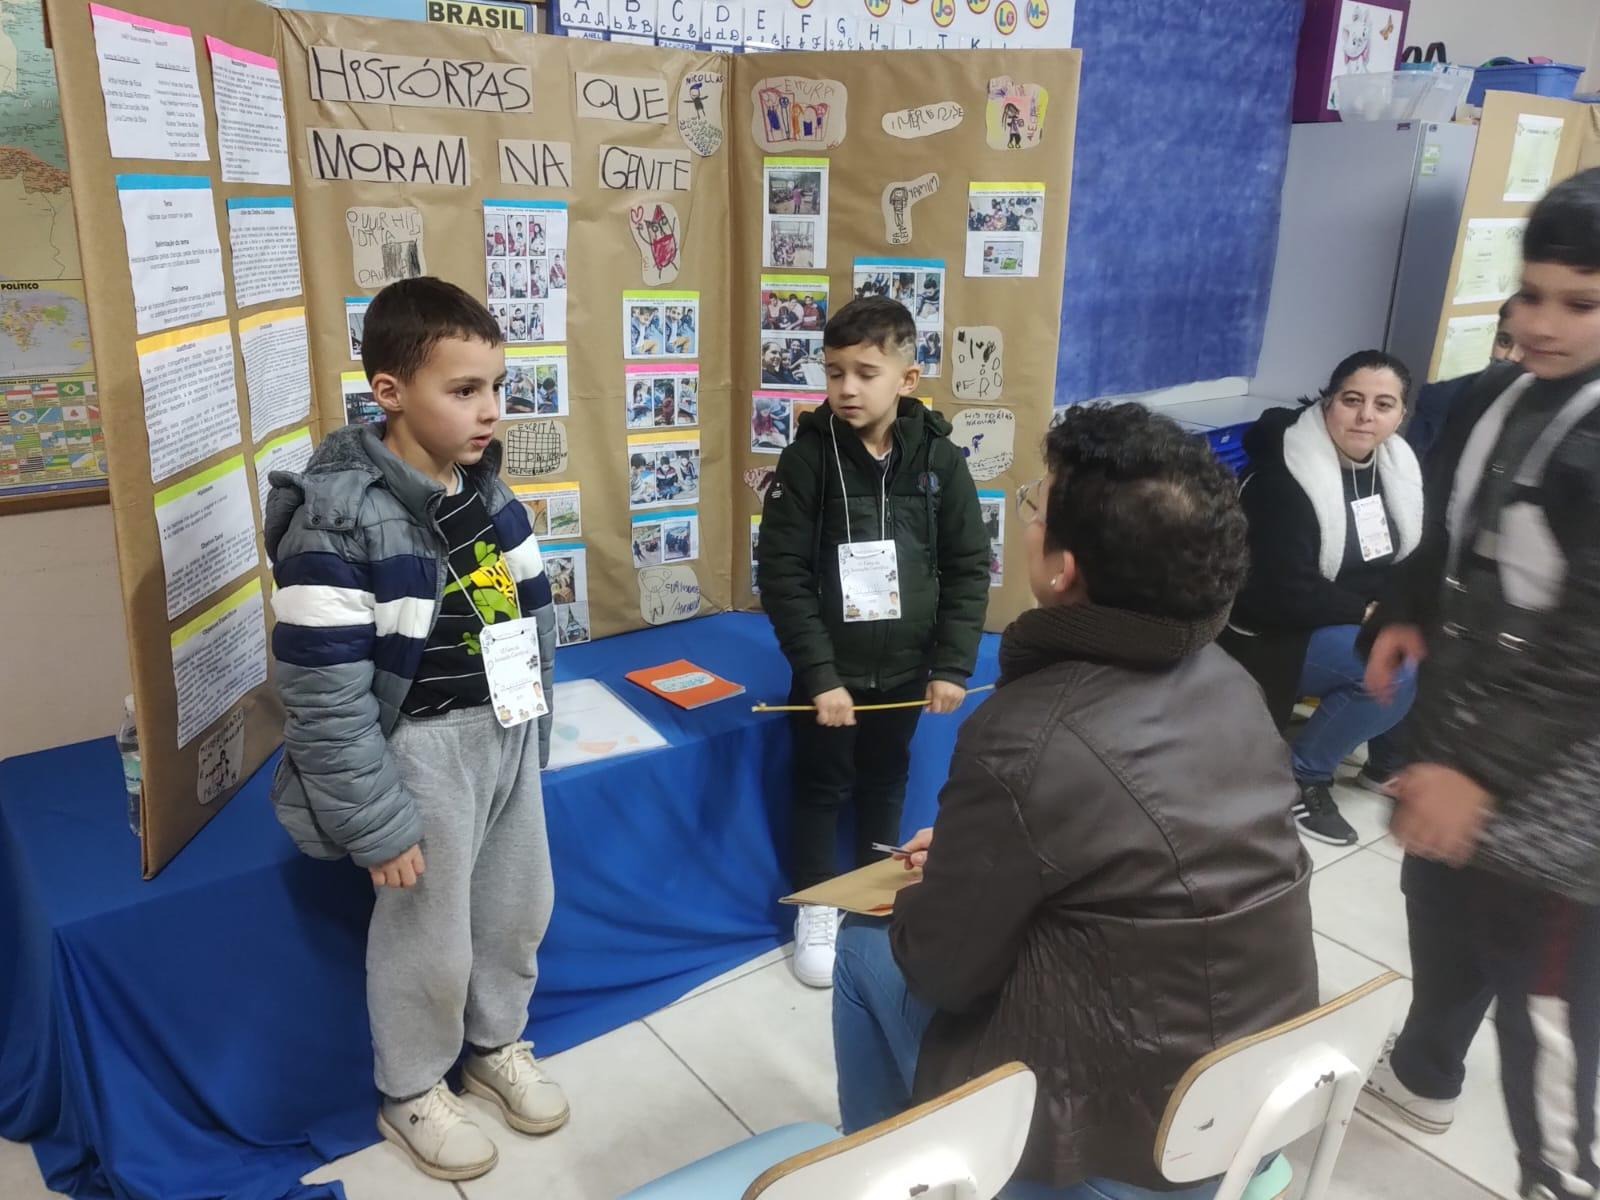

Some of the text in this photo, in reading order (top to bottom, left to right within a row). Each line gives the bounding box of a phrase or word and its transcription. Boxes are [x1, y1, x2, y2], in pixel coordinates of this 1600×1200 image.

[429, 2, 523, 30] BRASIL
[581, 78, 669, 121] QUE
[312, 129, 691, 190] MORAM NA GENTE
